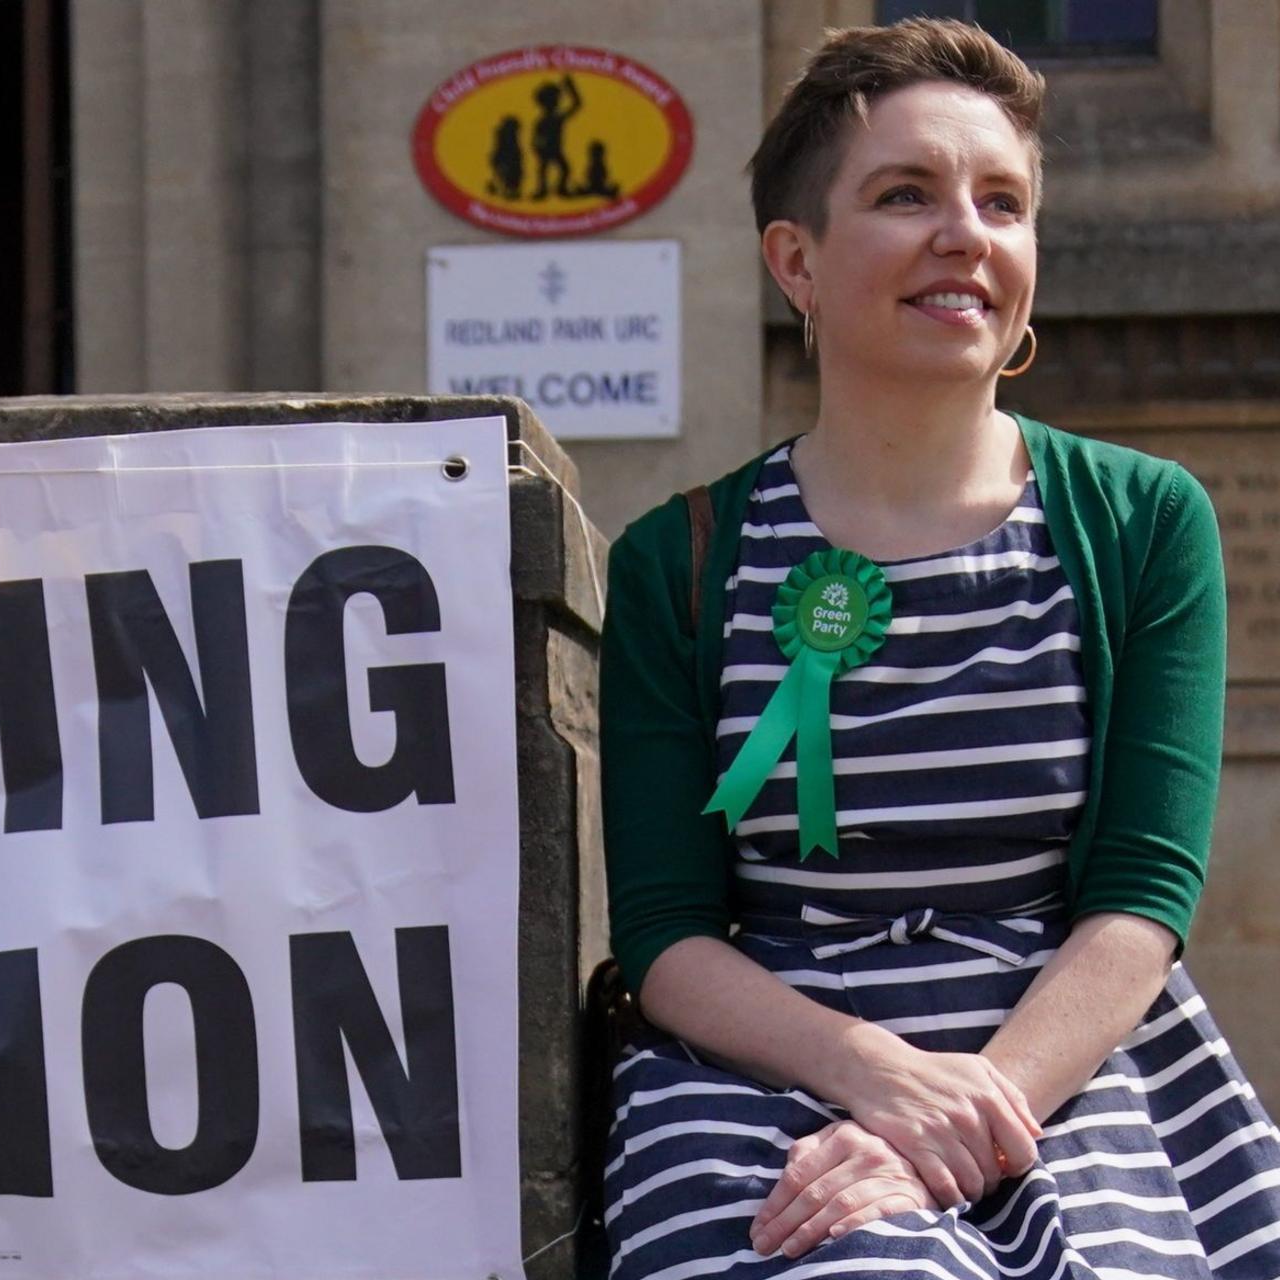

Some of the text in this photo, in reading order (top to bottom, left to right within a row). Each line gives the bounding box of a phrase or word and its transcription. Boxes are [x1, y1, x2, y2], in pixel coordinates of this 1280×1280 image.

[445, 313, 660, 345] REDLAND PARK URC
[449, 370, 659, 406] WELCOME
[813, 606, 851, 621] Green
[812, 620, 847, 637] Party
